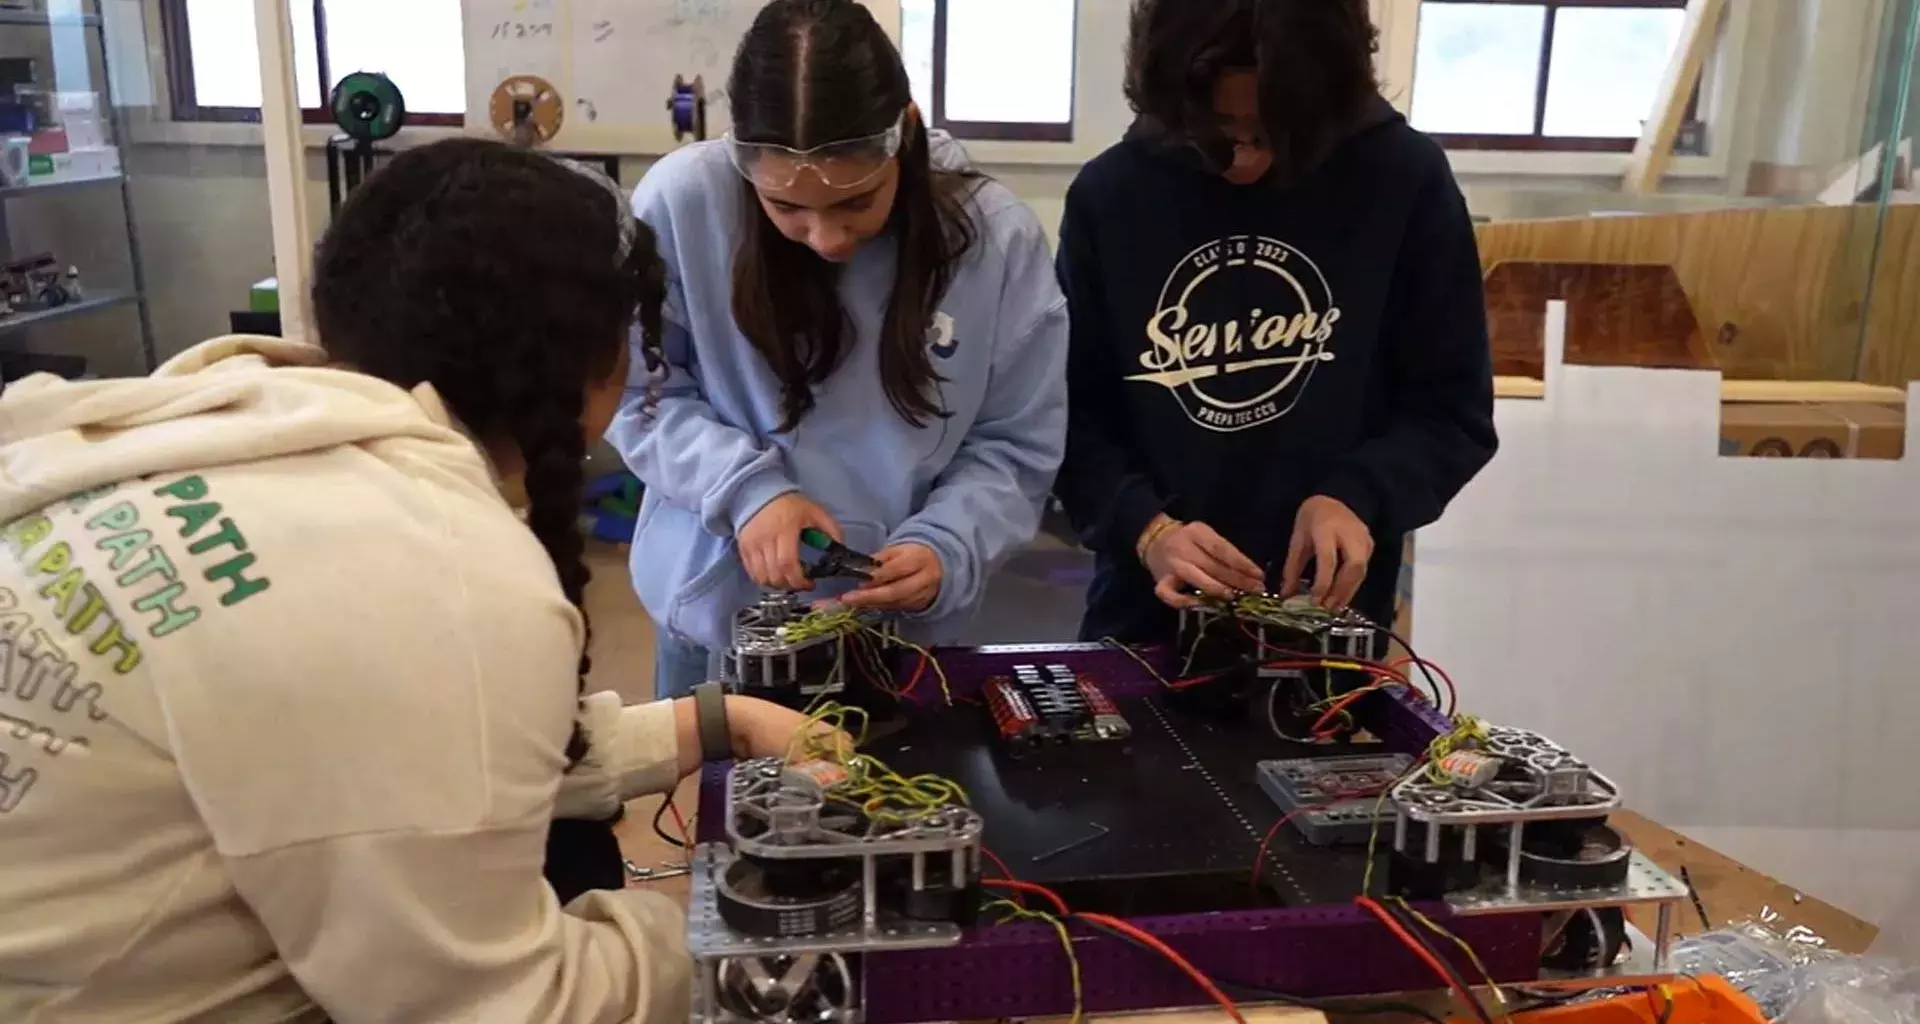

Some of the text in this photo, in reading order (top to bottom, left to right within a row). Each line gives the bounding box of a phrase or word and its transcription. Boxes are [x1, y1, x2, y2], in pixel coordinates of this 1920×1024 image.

[1193, 244, 1233, 268] CLAS
[1197, 406, 1233, 426] PREPA
[84, 500, 201, 638] PATH
[153, 474, 271, 606] PATH
[25, 541, 142, 675] PATH
